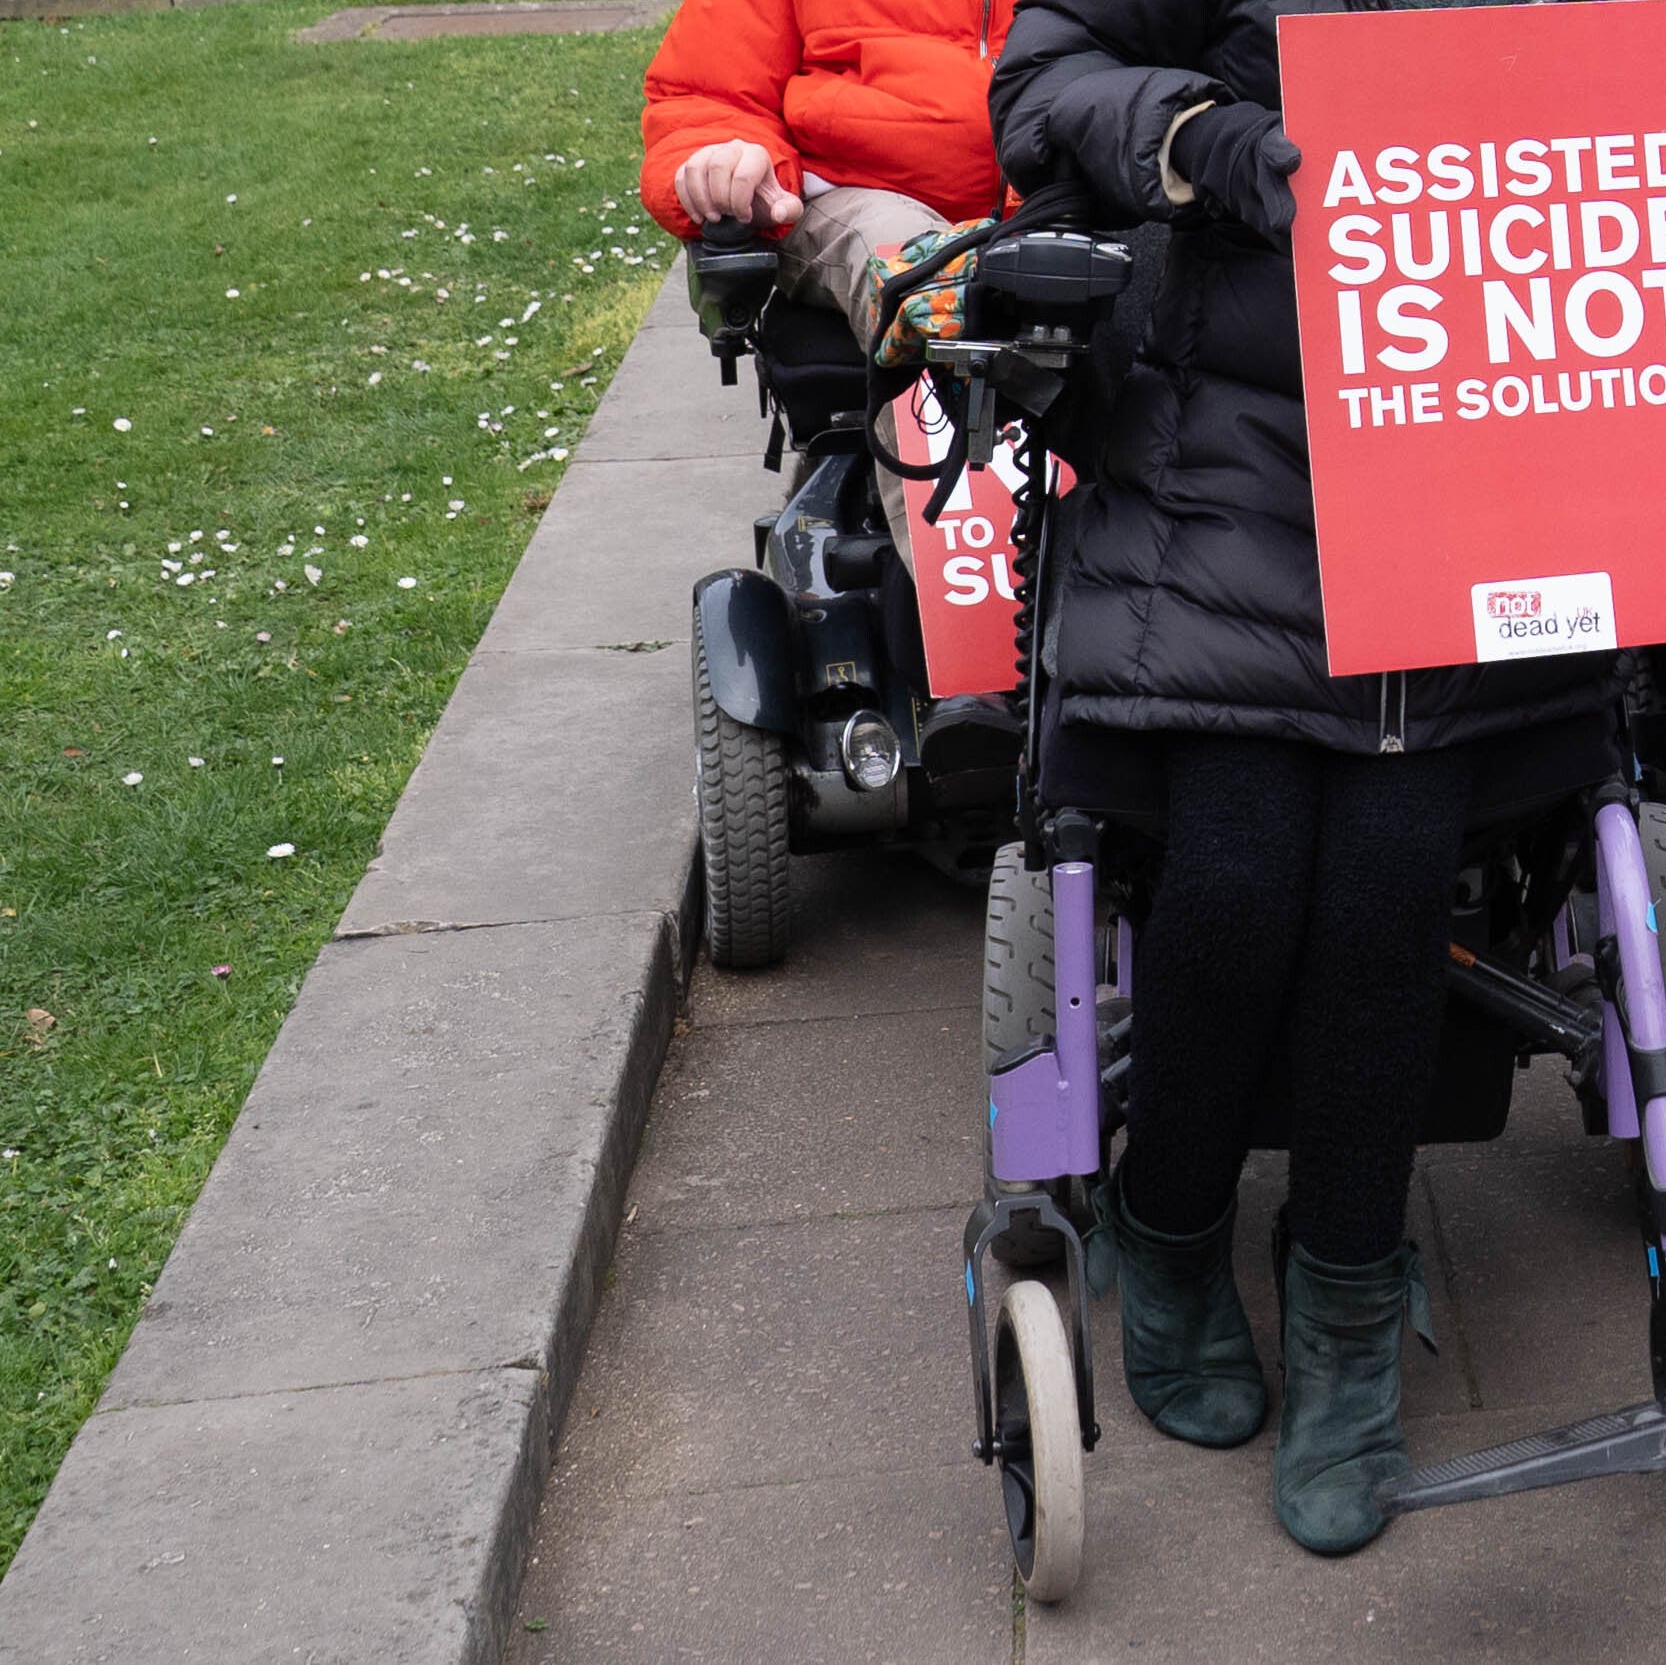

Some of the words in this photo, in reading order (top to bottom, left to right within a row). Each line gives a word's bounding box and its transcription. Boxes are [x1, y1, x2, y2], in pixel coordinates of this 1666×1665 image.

[1337, 284, 1449, 375] IS
[1338, 382, 1444, 429] THE
[936, 515, 995, 551] TO
[1491, 592, 1539, 618] not
[1498, 613, 1558, 638] dead
[1567, 612, 1600, 638] yet
